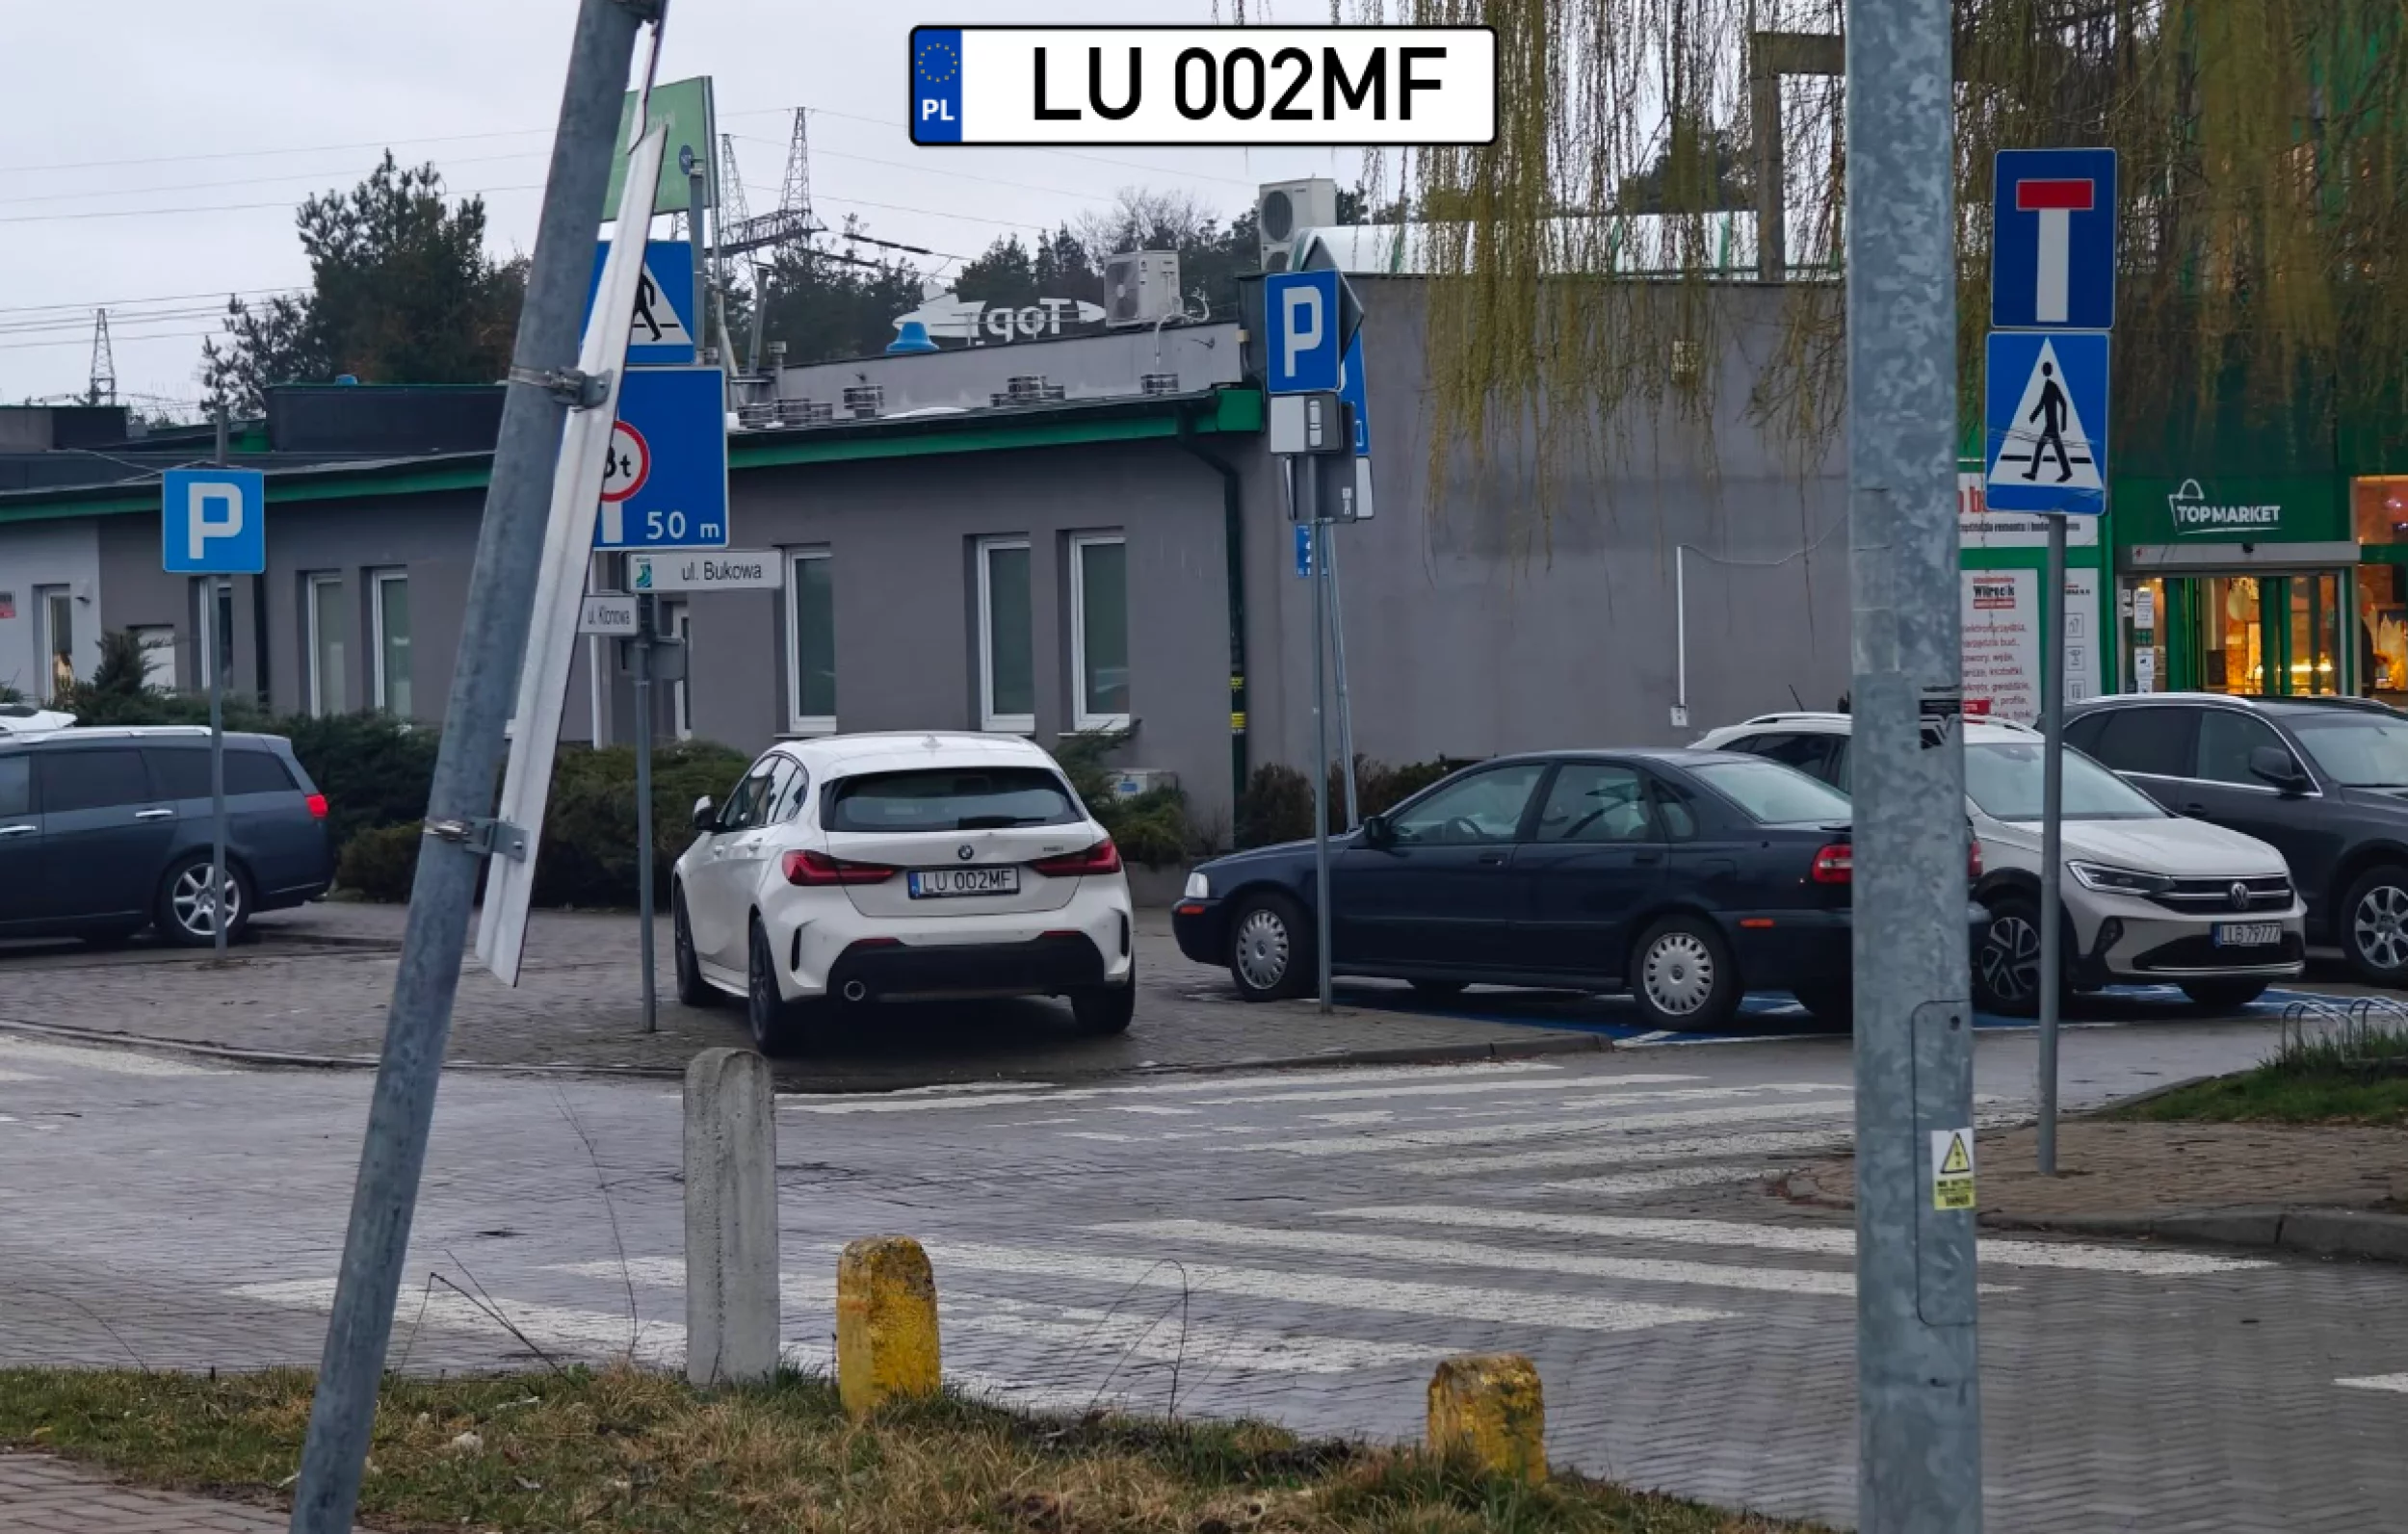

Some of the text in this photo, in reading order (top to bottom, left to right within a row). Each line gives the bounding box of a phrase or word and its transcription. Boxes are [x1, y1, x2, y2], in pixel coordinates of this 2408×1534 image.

[1282, 285, 1323, 377] P
[188, 481, 244, 559] P
[645, 510, 720, 540] 50 m
[681, 560, 763, 582] ul. Bukowa
[923, 871, 948, 894] LU
[954, 869, 1012, 891] 002MF
